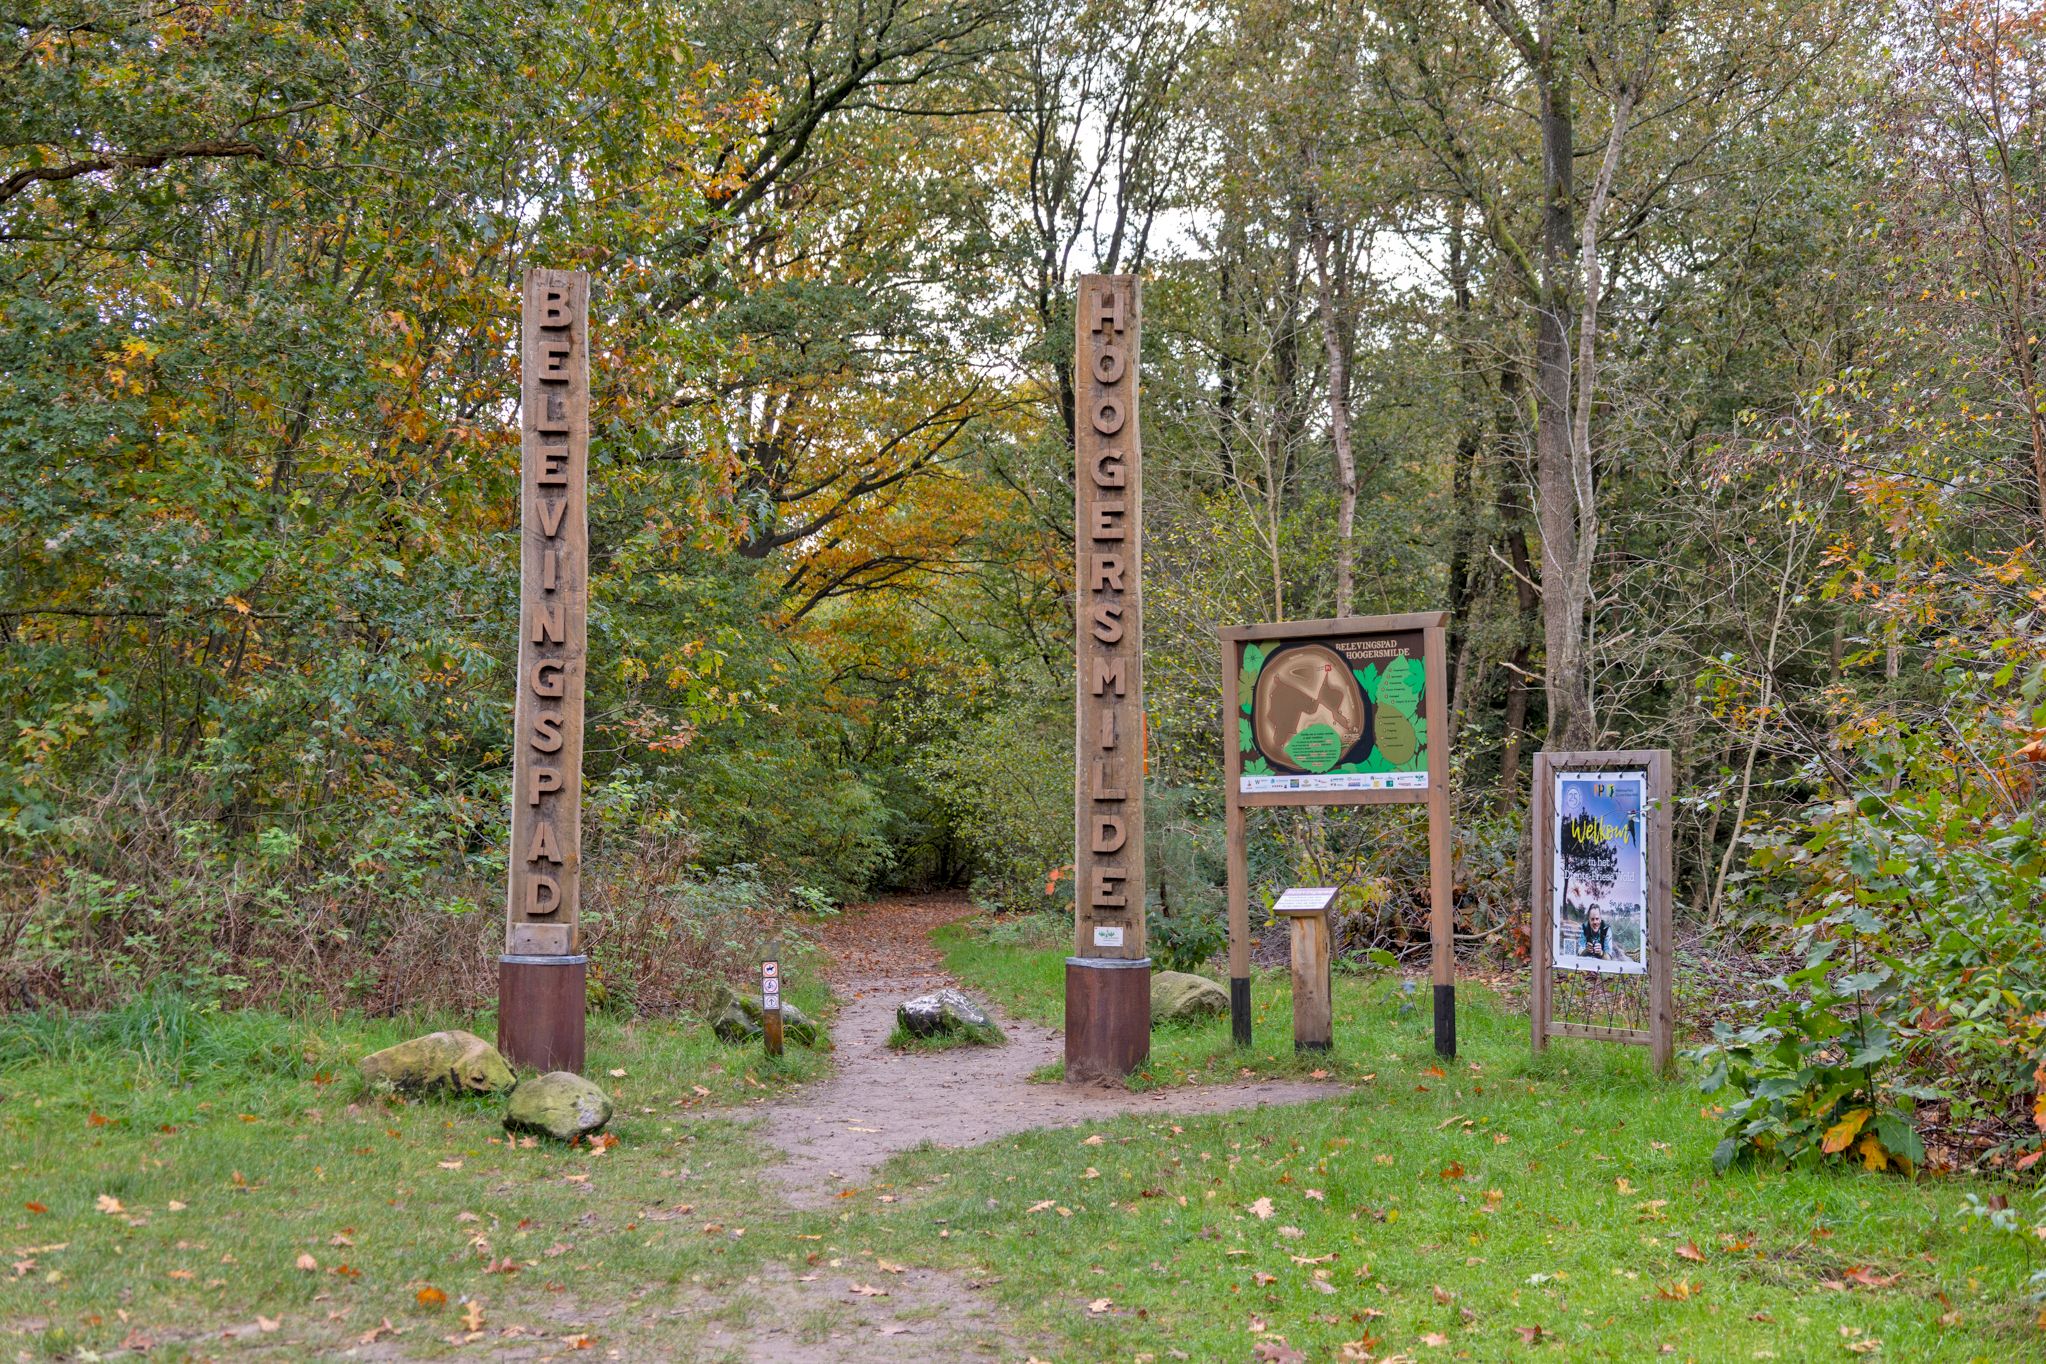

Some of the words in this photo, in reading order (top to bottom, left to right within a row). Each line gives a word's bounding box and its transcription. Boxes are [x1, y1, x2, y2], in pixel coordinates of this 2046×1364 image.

[526, 287, 572, 915] BELEVINGSPAD
[1091, 293, 1127, 908] HOOGERSMILDE
[1335, 639, 1397, 651] BELEVINGSPAD
[1346, 648, 1410, 660] HOOGERSMILDE
[1571, 816, 1630, 845] Welkom
[1597, 857, 1610, 867] het
